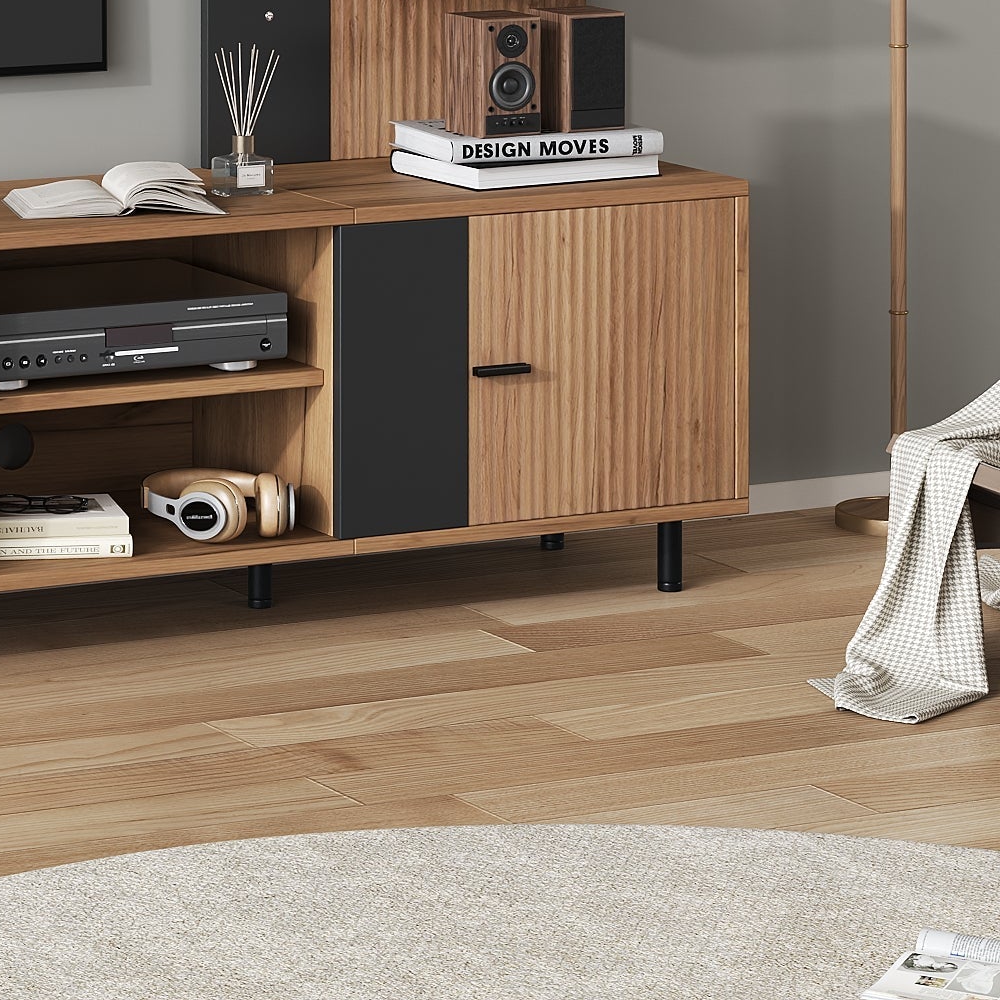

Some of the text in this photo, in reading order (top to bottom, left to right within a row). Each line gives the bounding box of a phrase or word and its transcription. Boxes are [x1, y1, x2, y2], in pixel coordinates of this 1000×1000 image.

[462, 139, 609, 159] DESIGN MOVES
[59, 546, 100, 554] FUTURE
